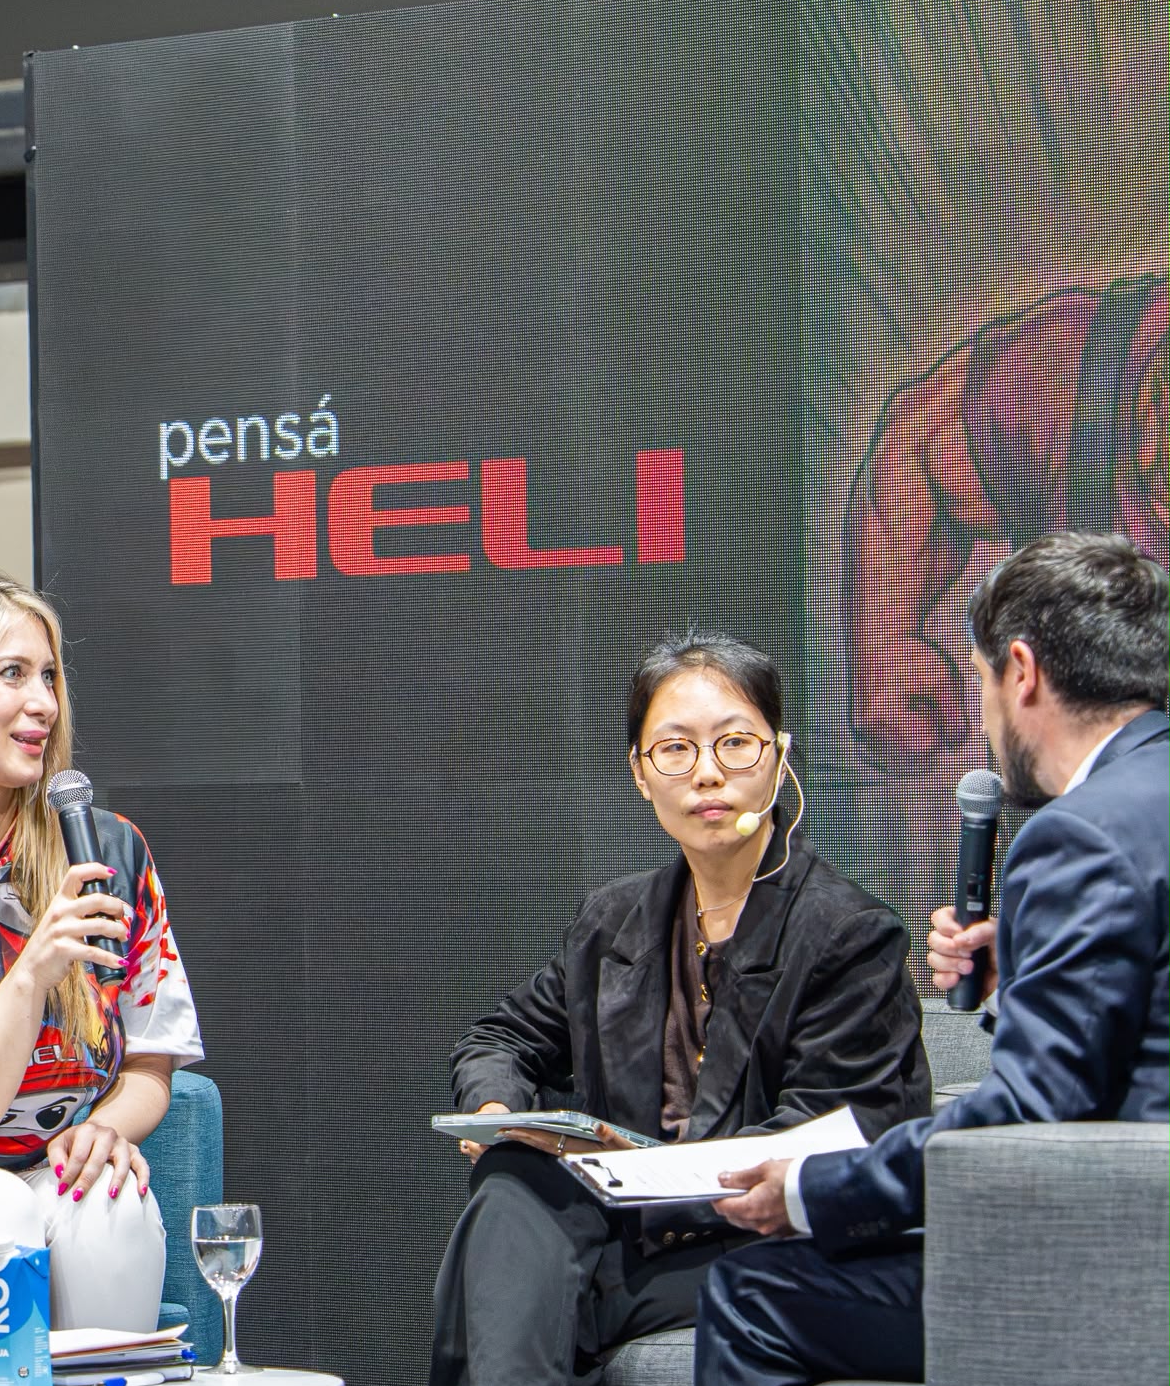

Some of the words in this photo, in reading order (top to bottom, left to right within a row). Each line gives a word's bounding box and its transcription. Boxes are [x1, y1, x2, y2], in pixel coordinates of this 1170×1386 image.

[159, 395, 339, 479] pensá
[169, 447, 686, 585] HELI
[28, 1042, 83, 1067] ELI
